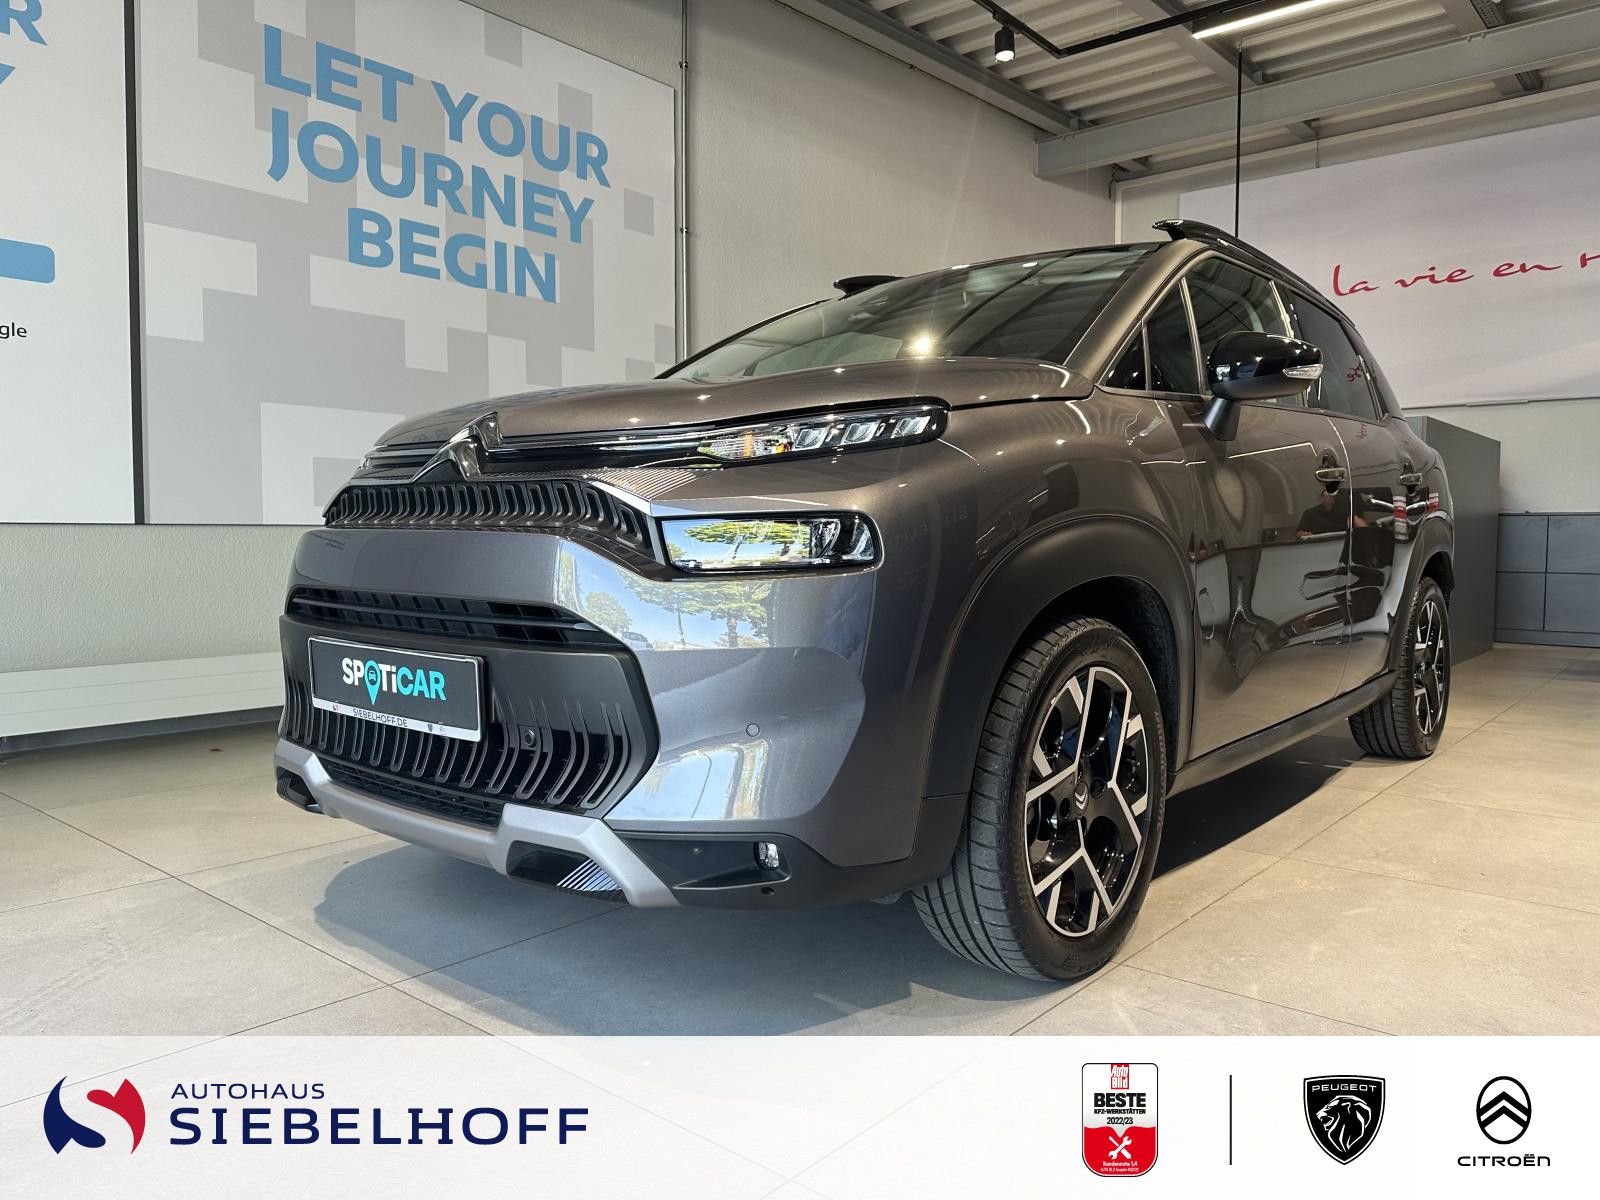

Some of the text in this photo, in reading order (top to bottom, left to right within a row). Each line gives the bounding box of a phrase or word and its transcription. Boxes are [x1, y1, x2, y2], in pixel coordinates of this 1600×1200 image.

[263, 24, 611, 188] LET YOUR
[267, 107, 595, 245] JOURNEY
[347, 207, 557, 304] BEGIN
[1332, 264, 1379, 297] la
[1394, 266, 1474, 289] vie
[1492, 261, 1562, 278] en
[0, 322, 27, 339] gle
[352, 708, 408, 728] SIEBELHOFF.DE
